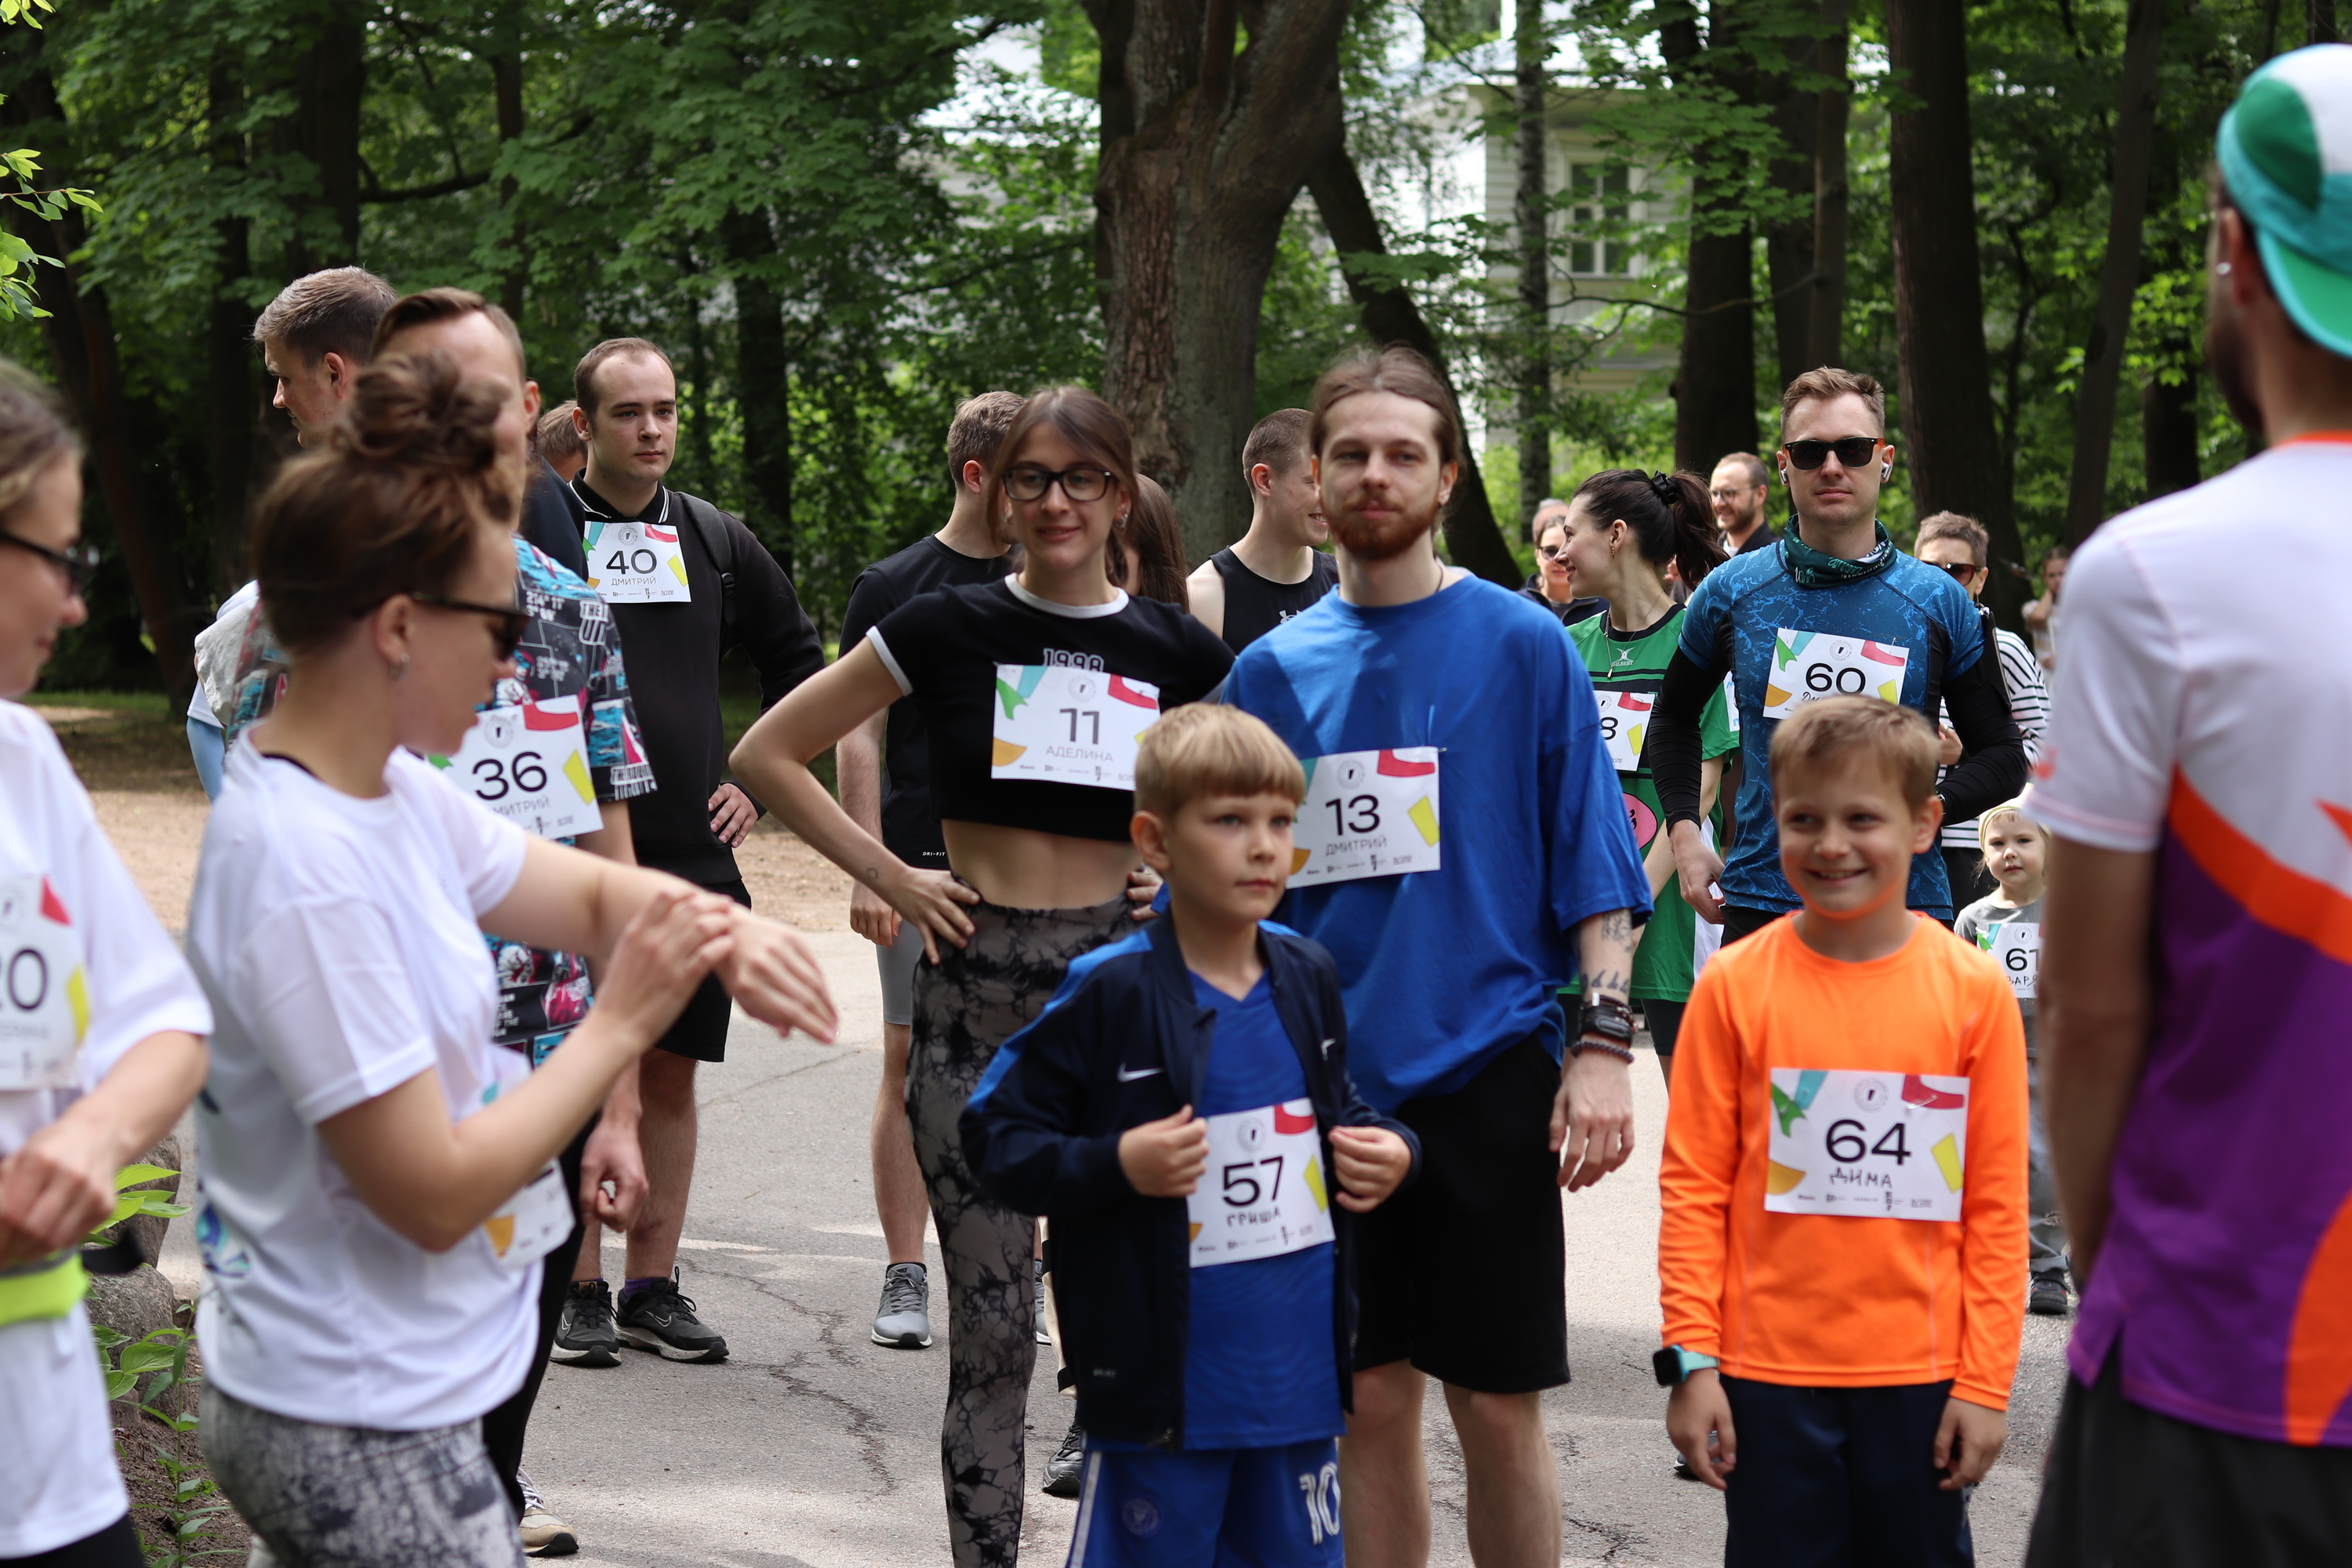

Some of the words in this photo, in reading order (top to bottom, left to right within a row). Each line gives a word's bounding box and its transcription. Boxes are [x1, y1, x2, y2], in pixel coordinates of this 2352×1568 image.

[606, 549, 657, 575] 40
[611, 575, 657, 586] ДМИТРИЙ
[1806, 662, 1866, 695] 60
[1059, 708, 1100, 745] 11
[1599, 717, 1618, 740] 8
[1046, 746, 1114, 763] АДЕЛИНА
[472, 751, 547, 800] 36
[492, 794, 550, 816] МИТРИЙ
[1326, 795, 1381, 836] 13
[1326, 835, 1388, 857] ДМИТРИЙ
[0, 947, 49, 1011] 0
[1826, 1119, 1911, 1166] 64
[1222, 1156, 1283, 1207] 57
[1829, 1167, 1893, 1188] ДИМА
[1227, 1207, 1281, 1228] ГРИША
[1299, 1461, 1341, 1544] 10
